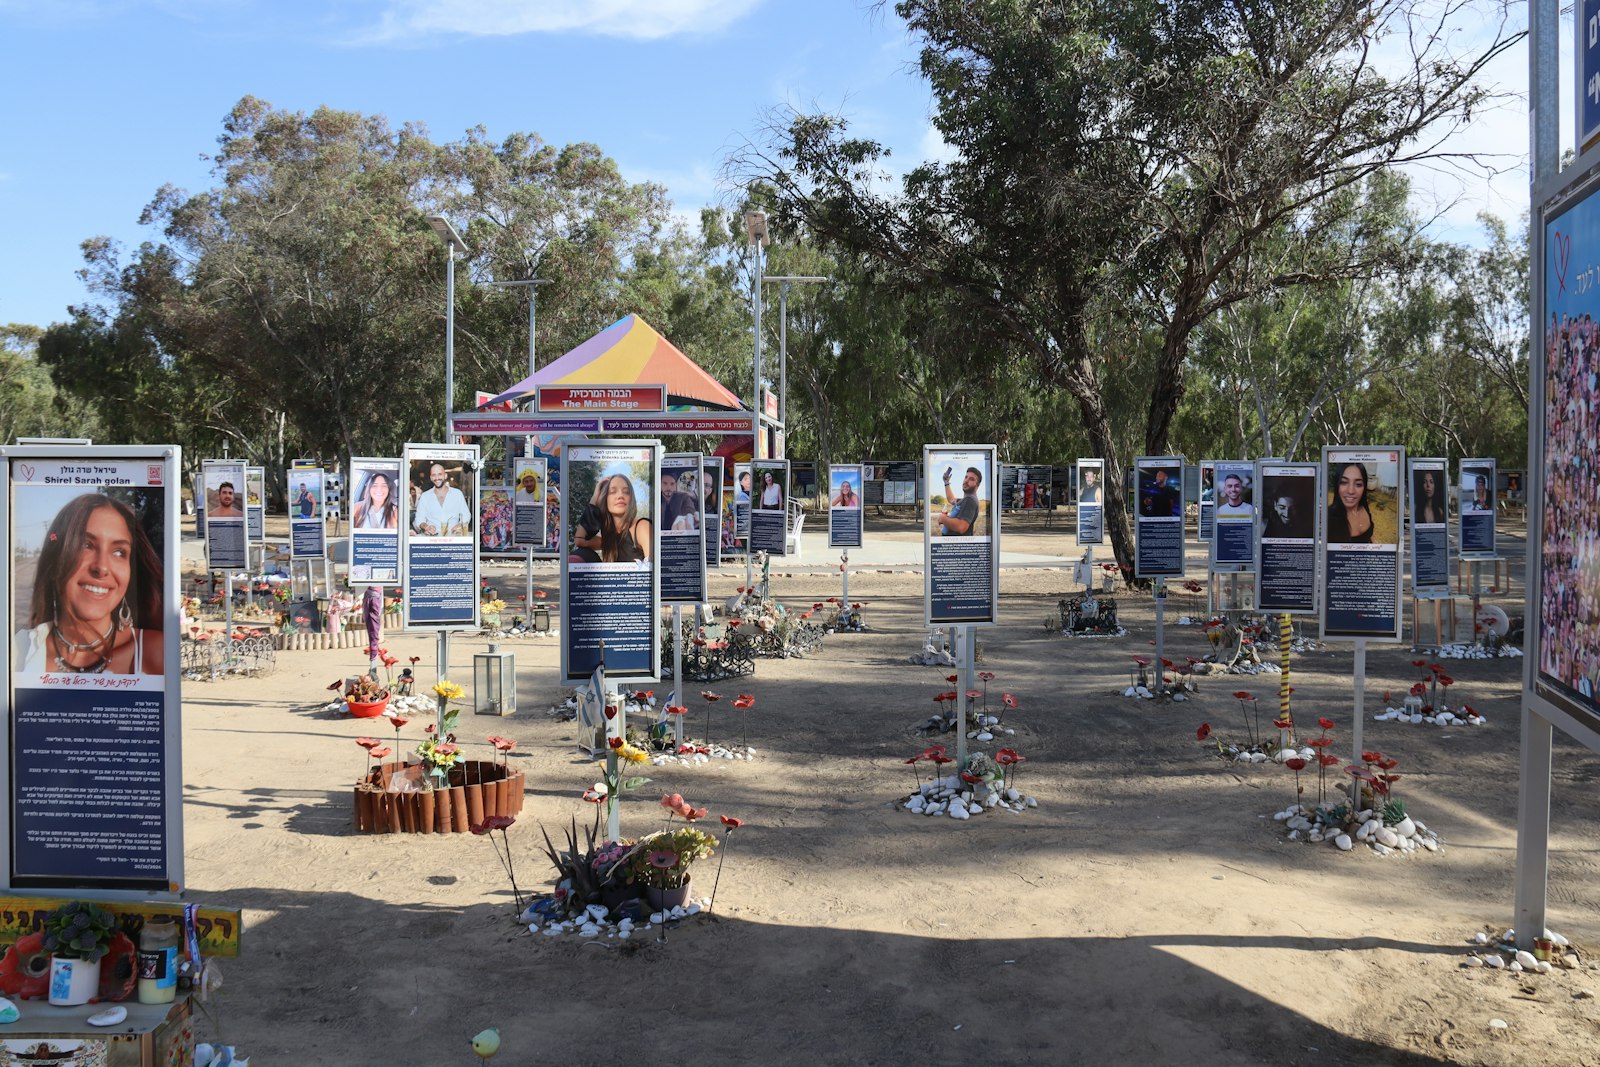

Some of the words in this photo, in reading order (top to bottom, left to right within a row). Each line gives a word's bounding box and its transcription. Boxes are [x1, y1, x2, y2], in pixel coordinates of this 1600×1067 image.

[569, 389, 606, 398] המרכזית
[608, 389, 632, 398] הבמה
[562, 400, 581, 408] The
[583, 400, 607, 408] Main
[610, 400, 639, 409] Stage
[60, 465, 74, 474] גולן
[95, 465, 117, 473] שיראל
[104, 477, 130, 486] golan
